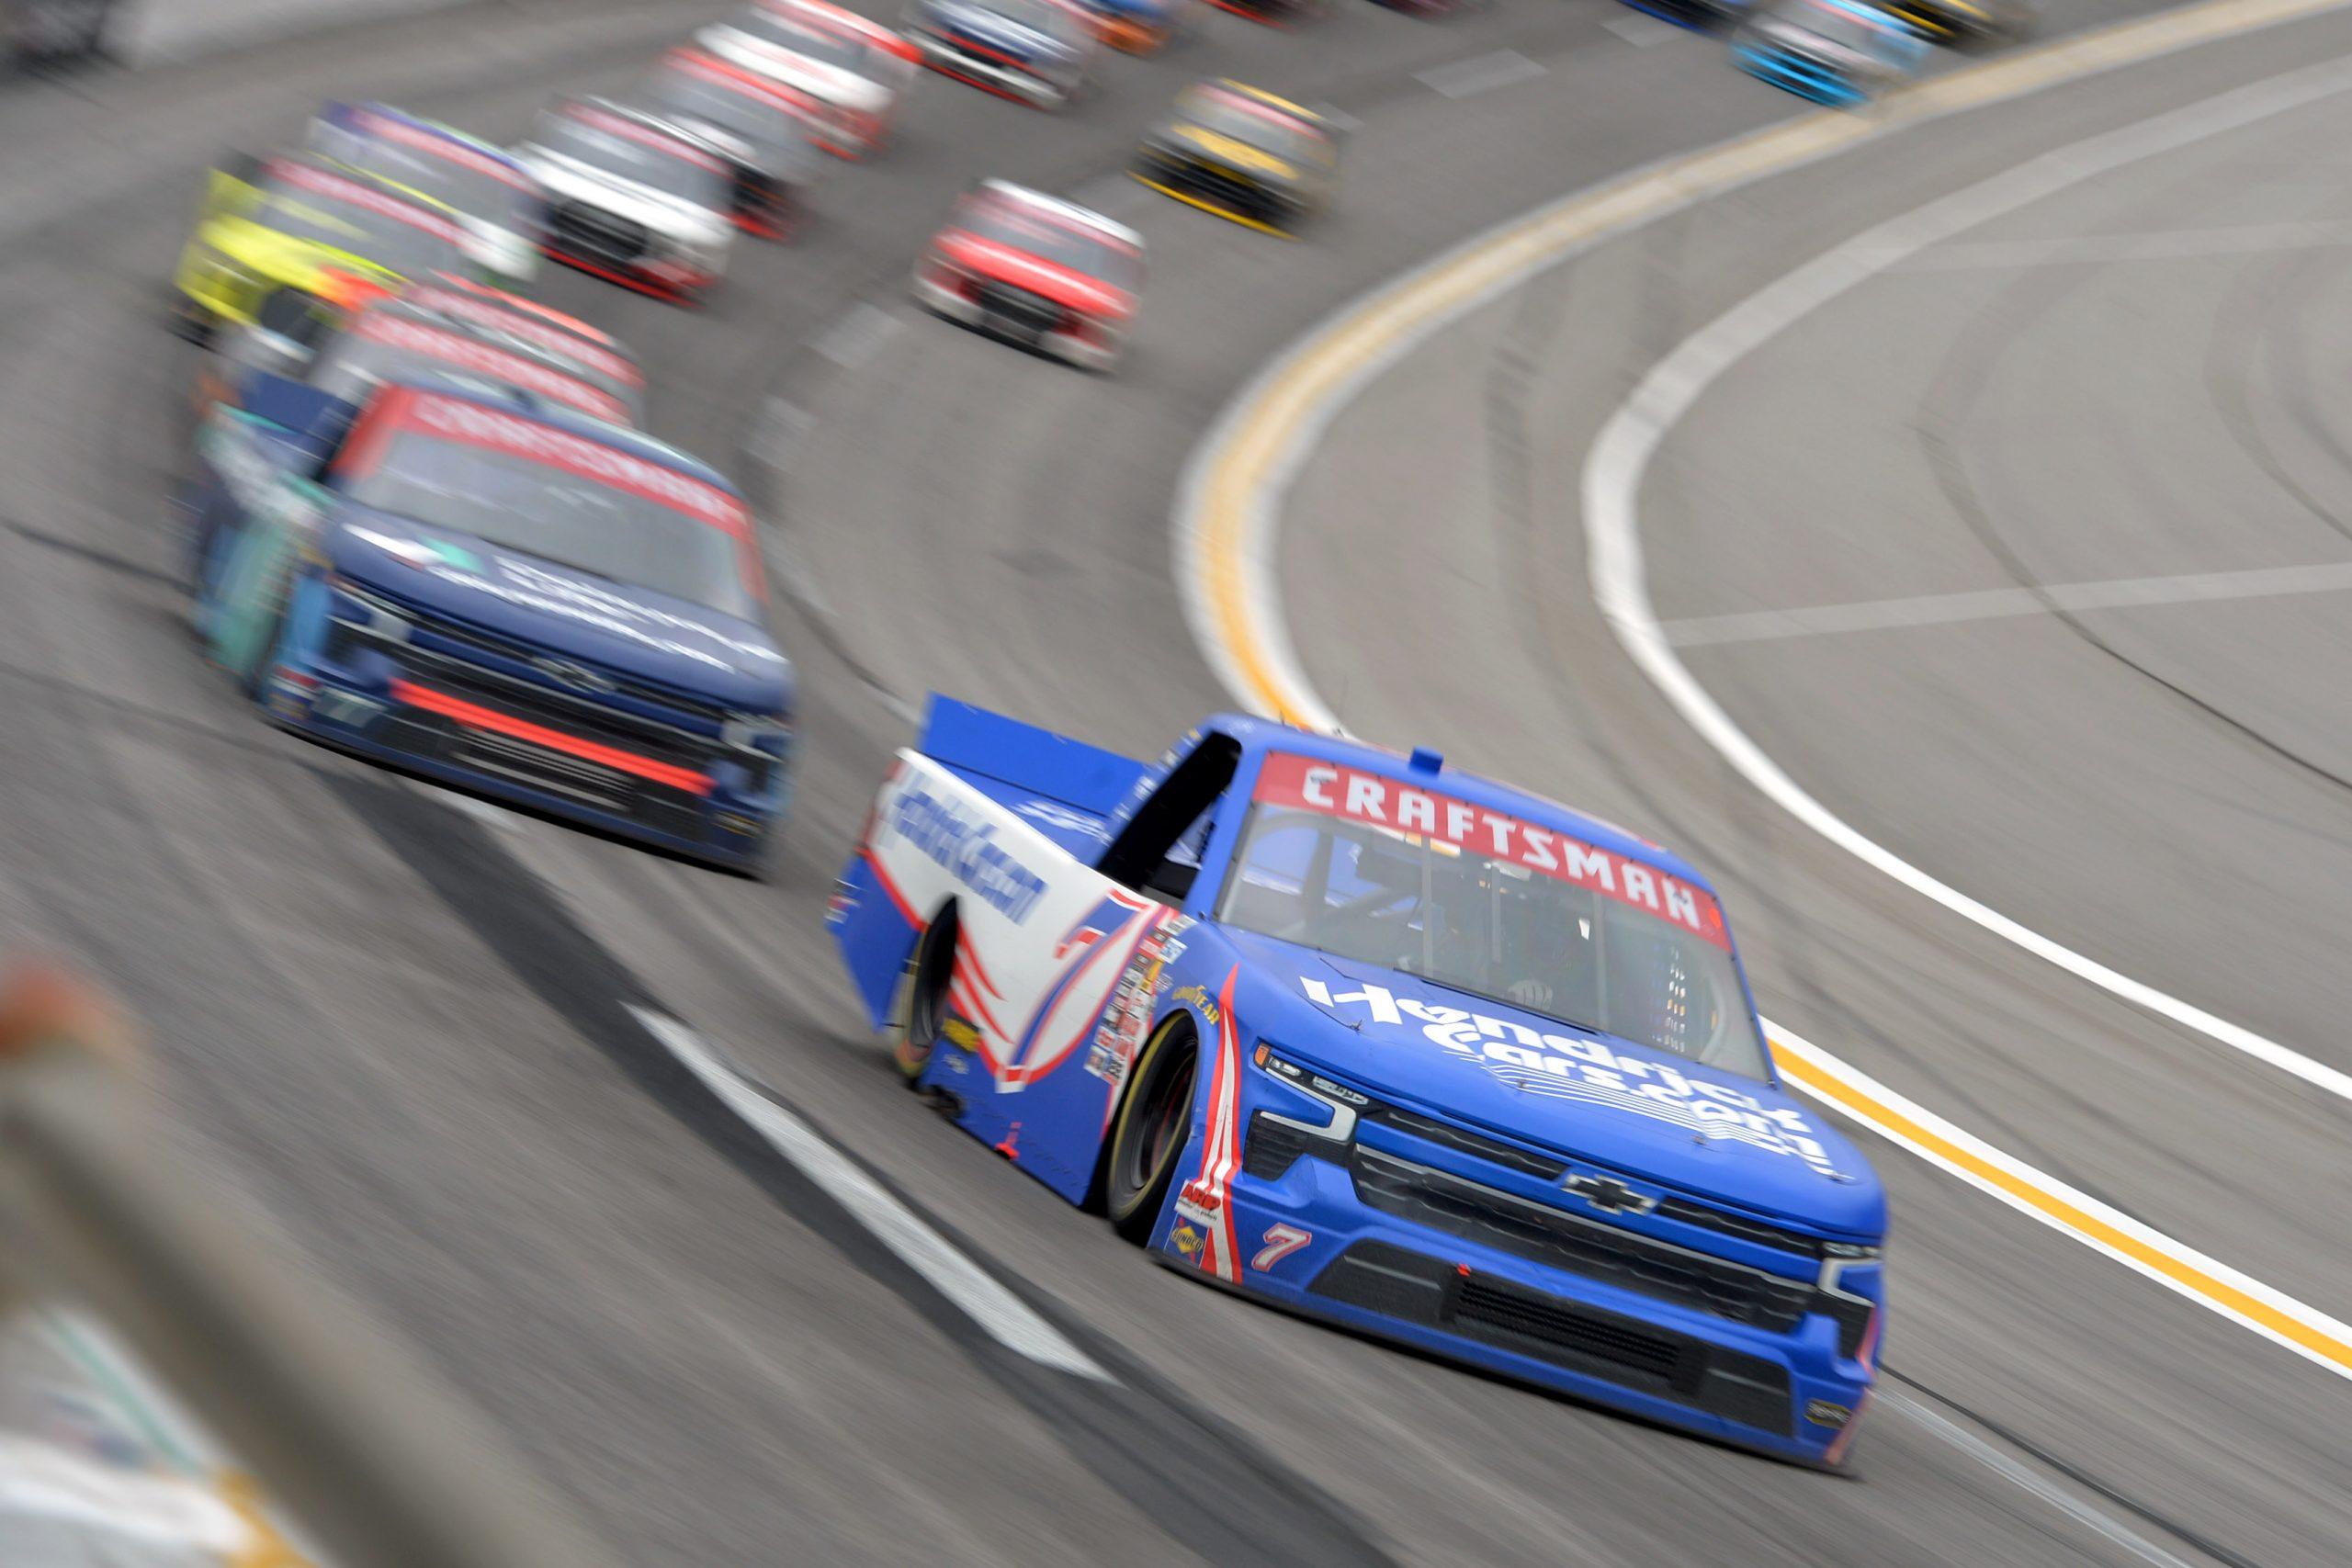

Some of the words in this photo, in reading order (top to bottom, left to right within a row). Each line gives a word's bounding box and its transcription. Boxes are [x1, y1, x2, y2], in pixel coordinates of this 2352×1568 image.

[1302, 766, 1700, 930] CRAFTSMAN
[1299, 976, 1814, 1133] Hendrick
[1251, 1223, 1312, 1272] 7
